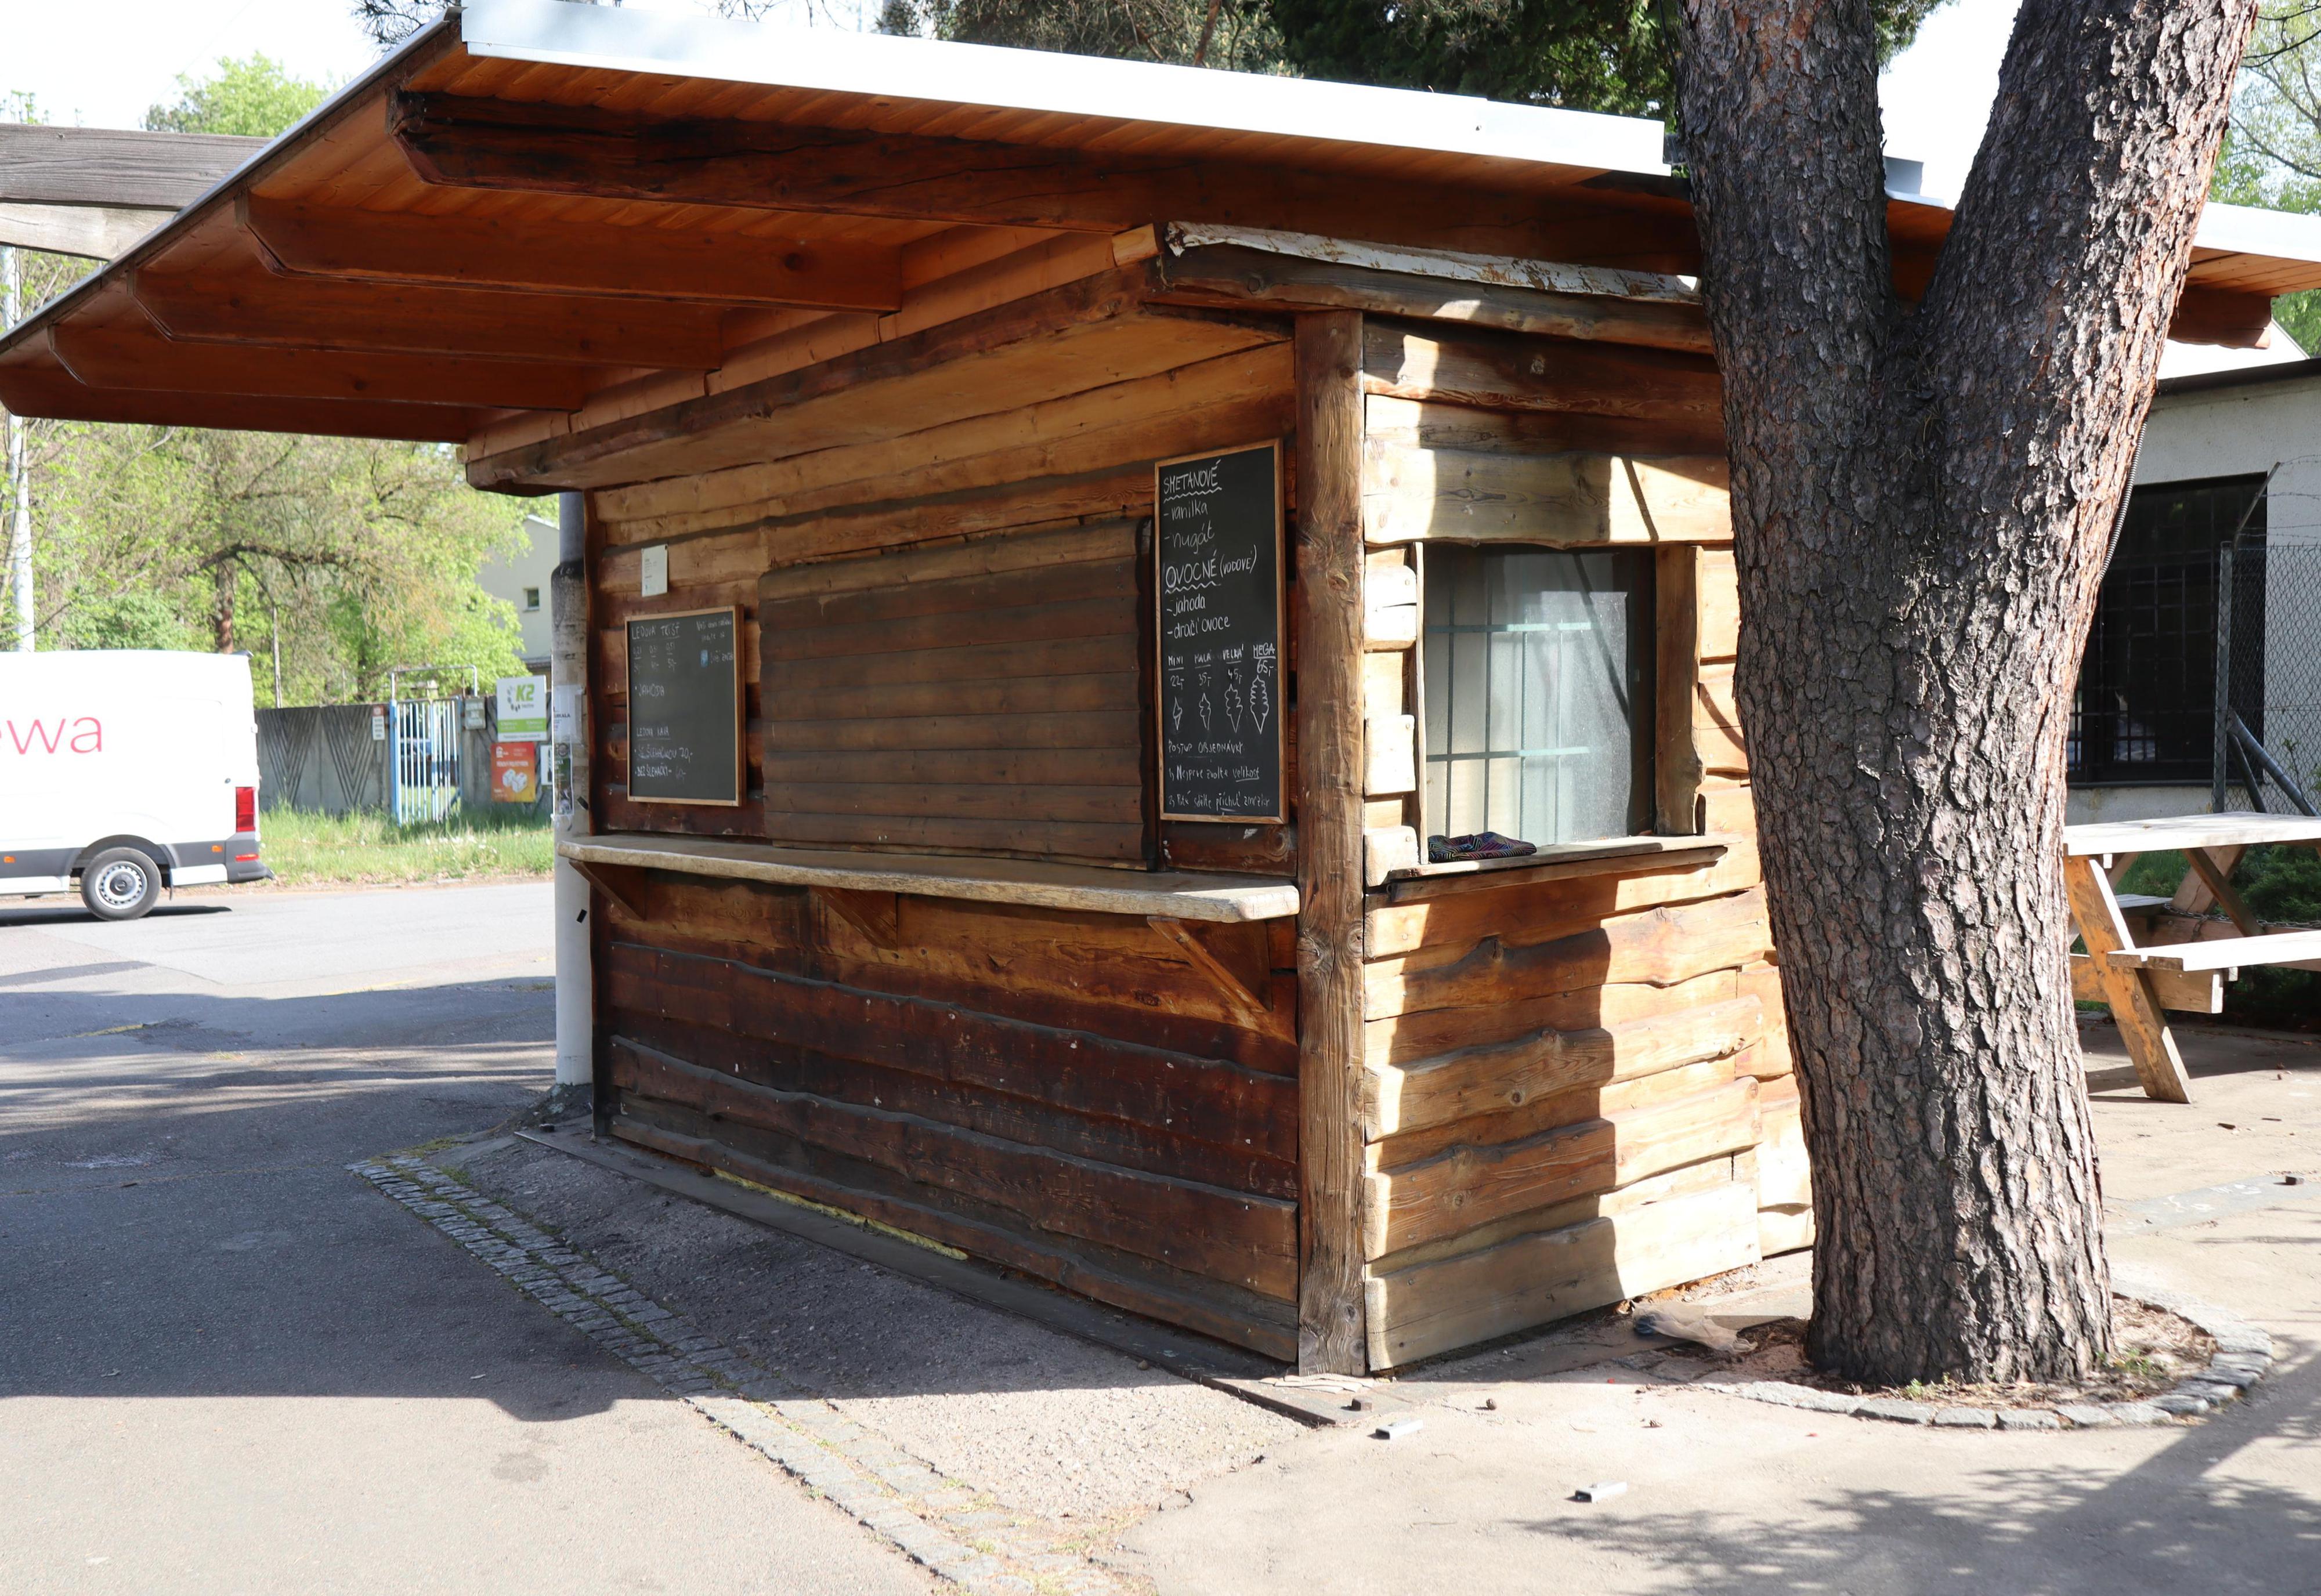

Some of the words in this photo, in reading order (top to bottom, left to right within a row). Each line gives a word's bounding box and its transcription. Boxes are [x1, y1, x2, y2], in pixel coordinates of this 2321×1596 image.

[1163, 459, 1221, 494] SMETANOVÉ
[1166, 549, 1217, 588] OVOCNÉ
[1168, 655, 1184, 666] MINI
[1253, 642, 1275, 657] MEGA
[516, 683, 535, 702] K2
[0, 716, 102, 755] wa
